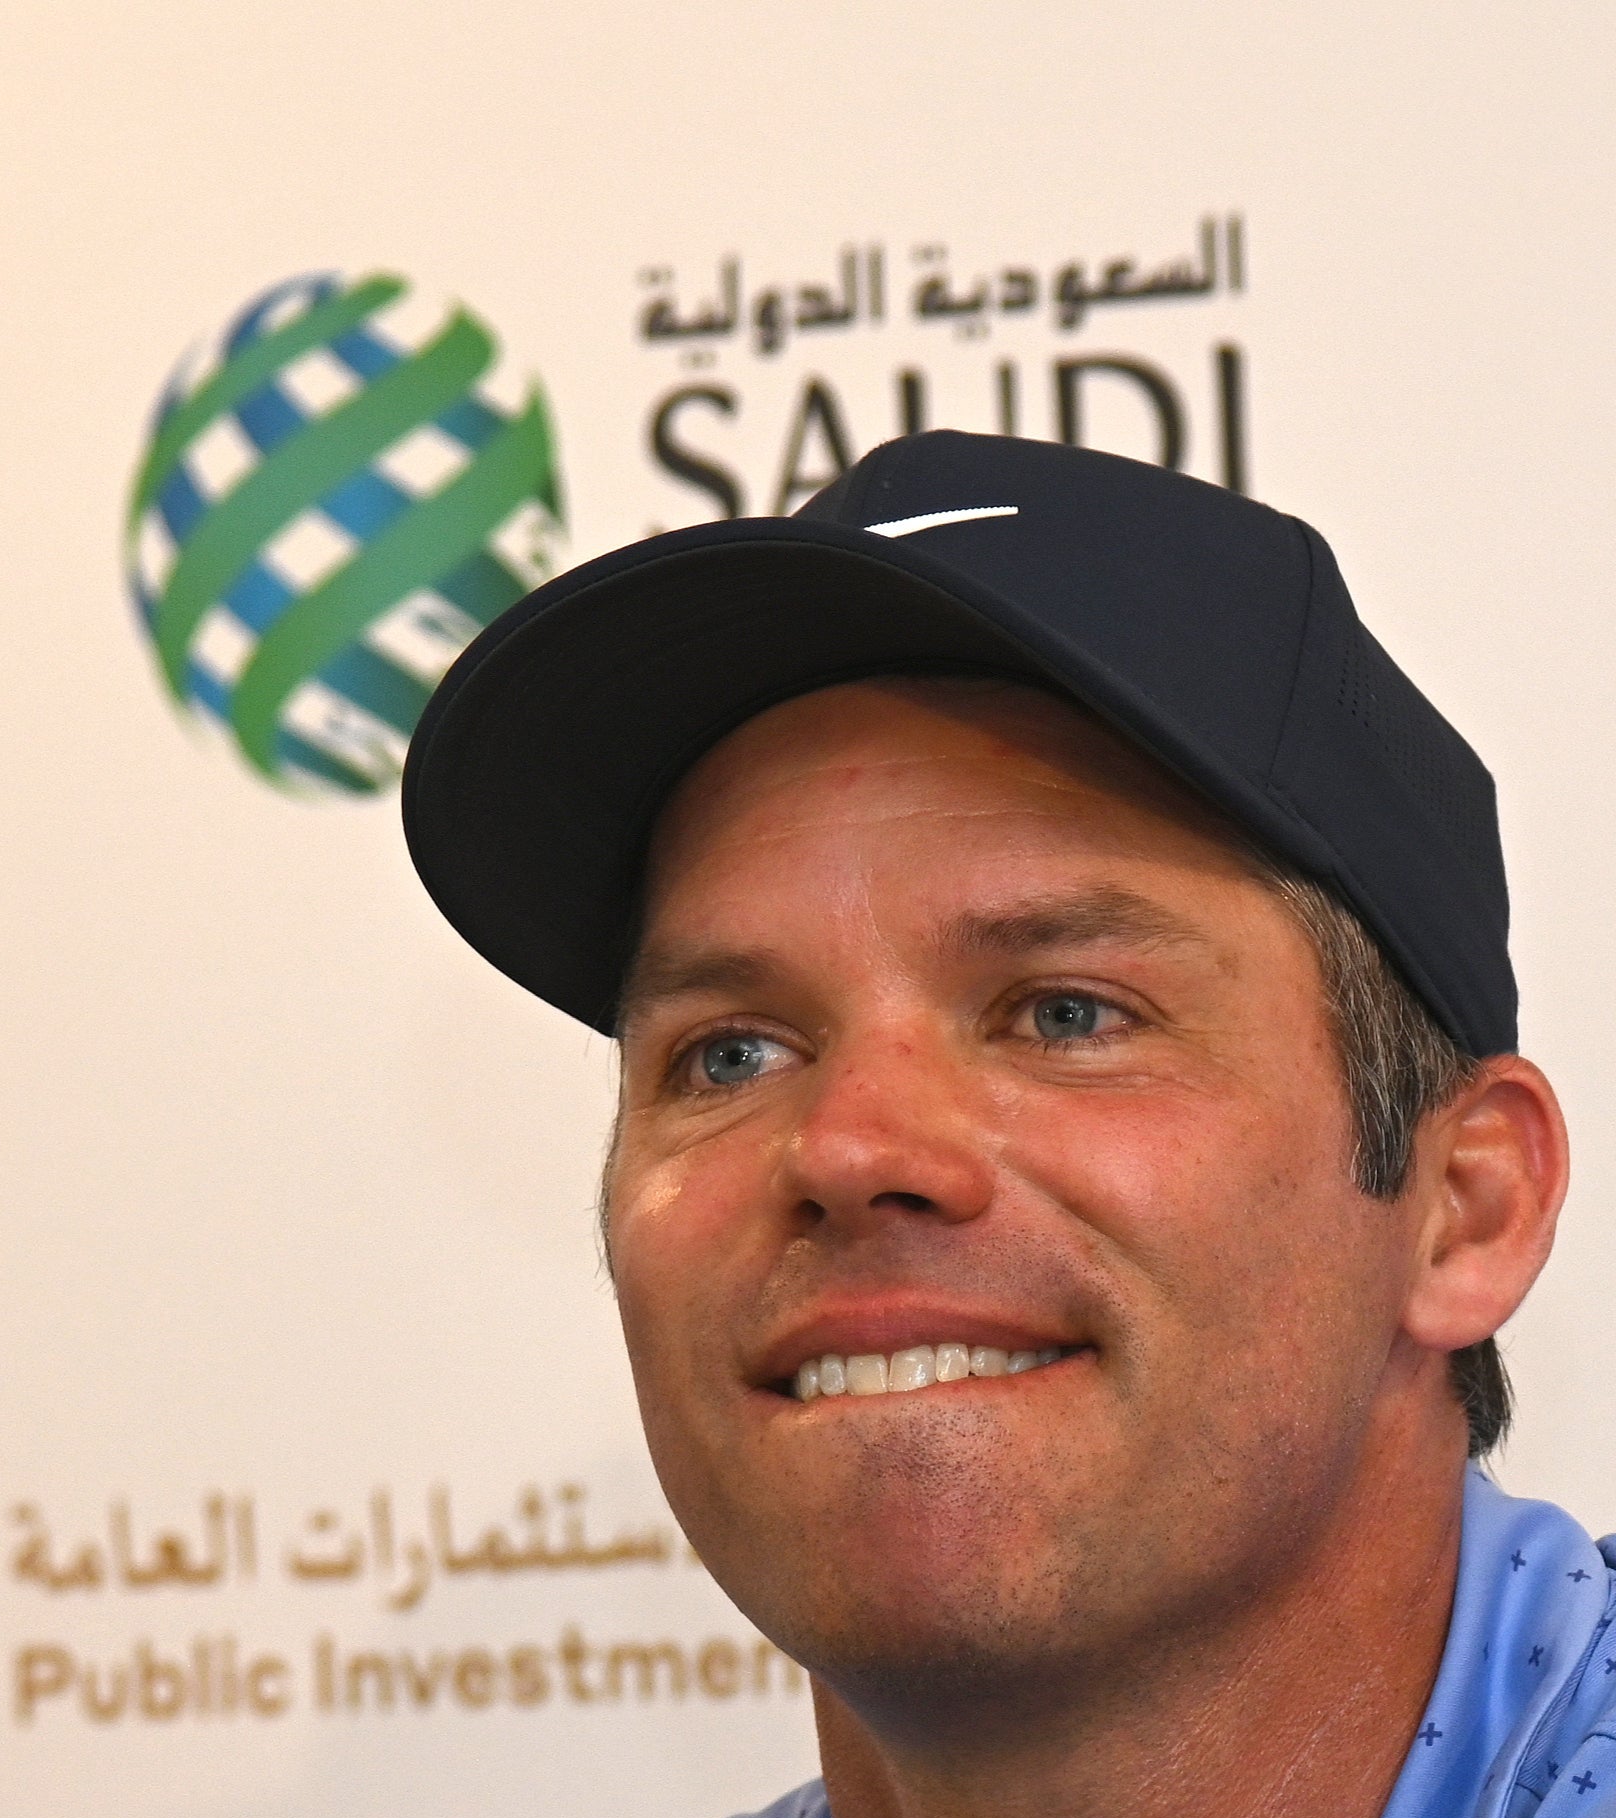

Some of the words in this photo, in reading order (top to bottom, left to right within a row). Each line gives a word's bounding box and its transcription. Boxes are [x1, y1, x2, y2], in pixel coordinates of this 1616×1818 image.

[637, 240, 884, 367] الدولية
[912, 210, 1244, 342] السعودية
[9, 1488, 257, 1592] العامة
[10, 1637, 295, 1728] Public
[313, 1624, 808, 1712] Investmen
